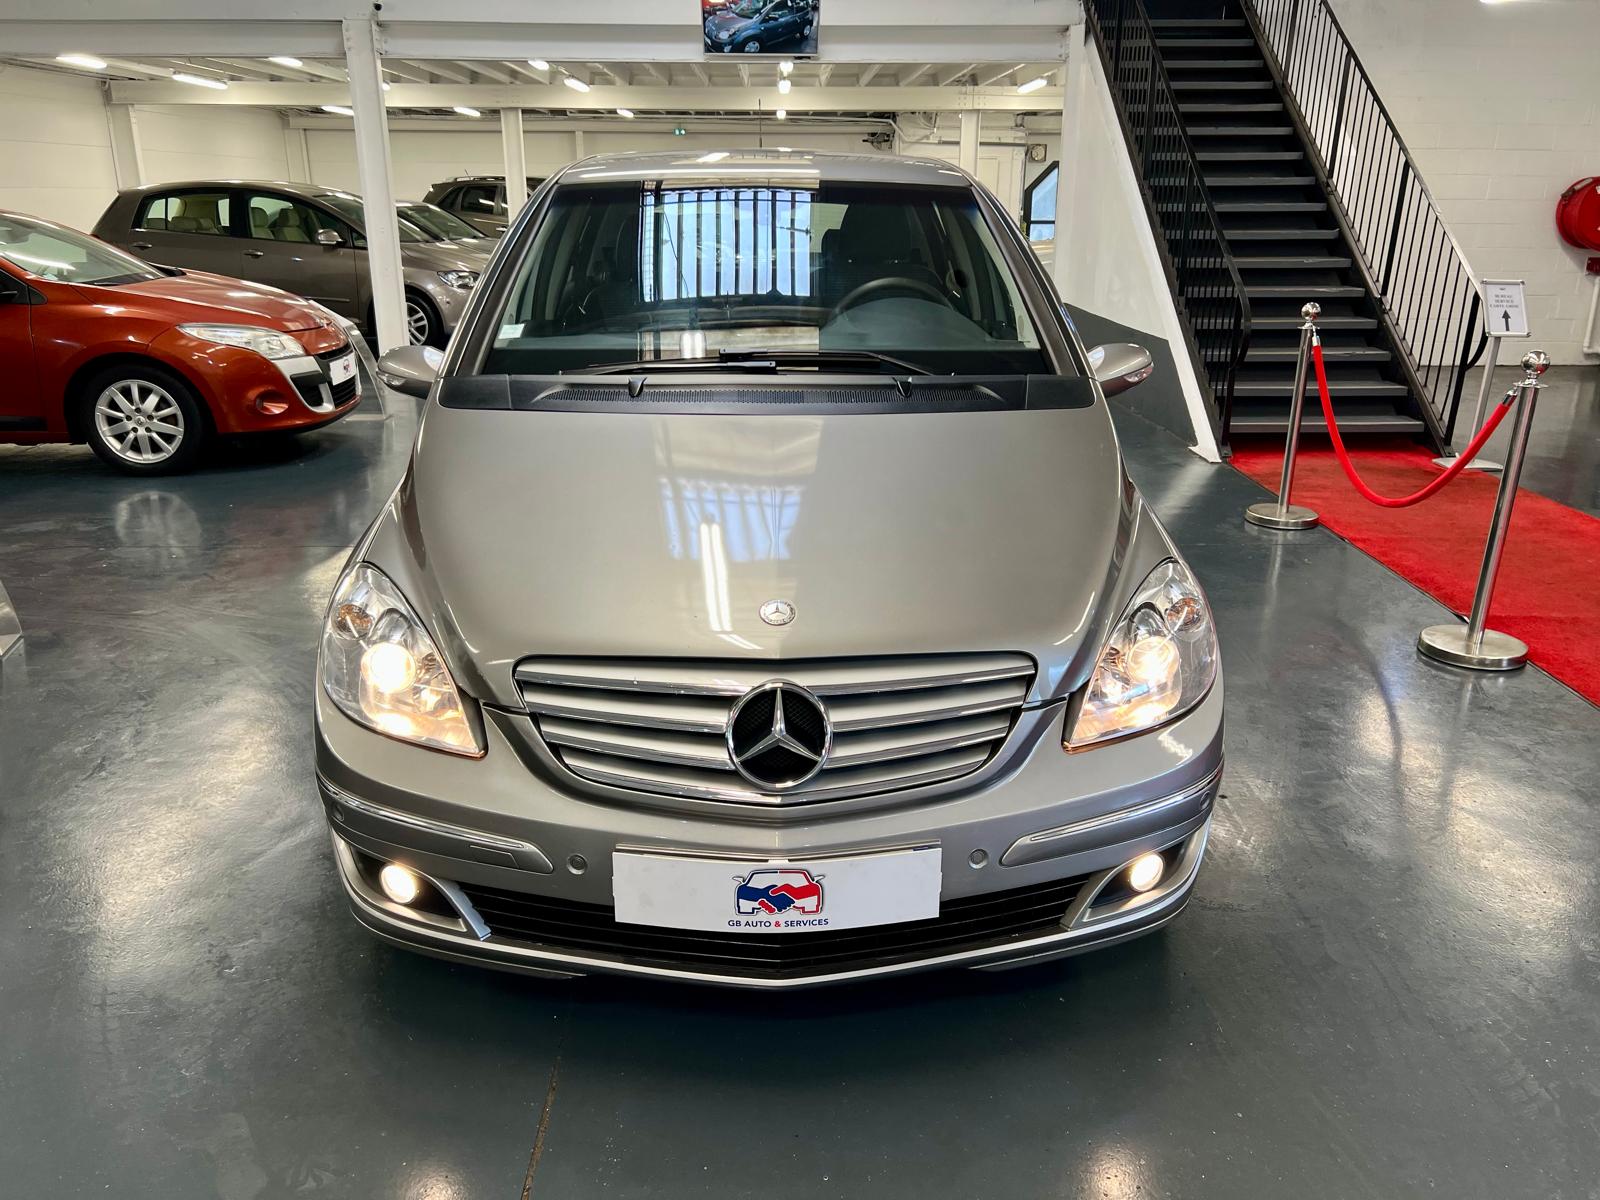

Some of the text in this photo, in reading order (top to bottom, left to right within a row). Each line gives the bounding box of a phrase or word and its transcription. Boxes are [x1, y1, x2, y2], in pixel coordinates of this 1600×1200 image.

[728, 918, 829, 928] GB AUTO & SERVICES
